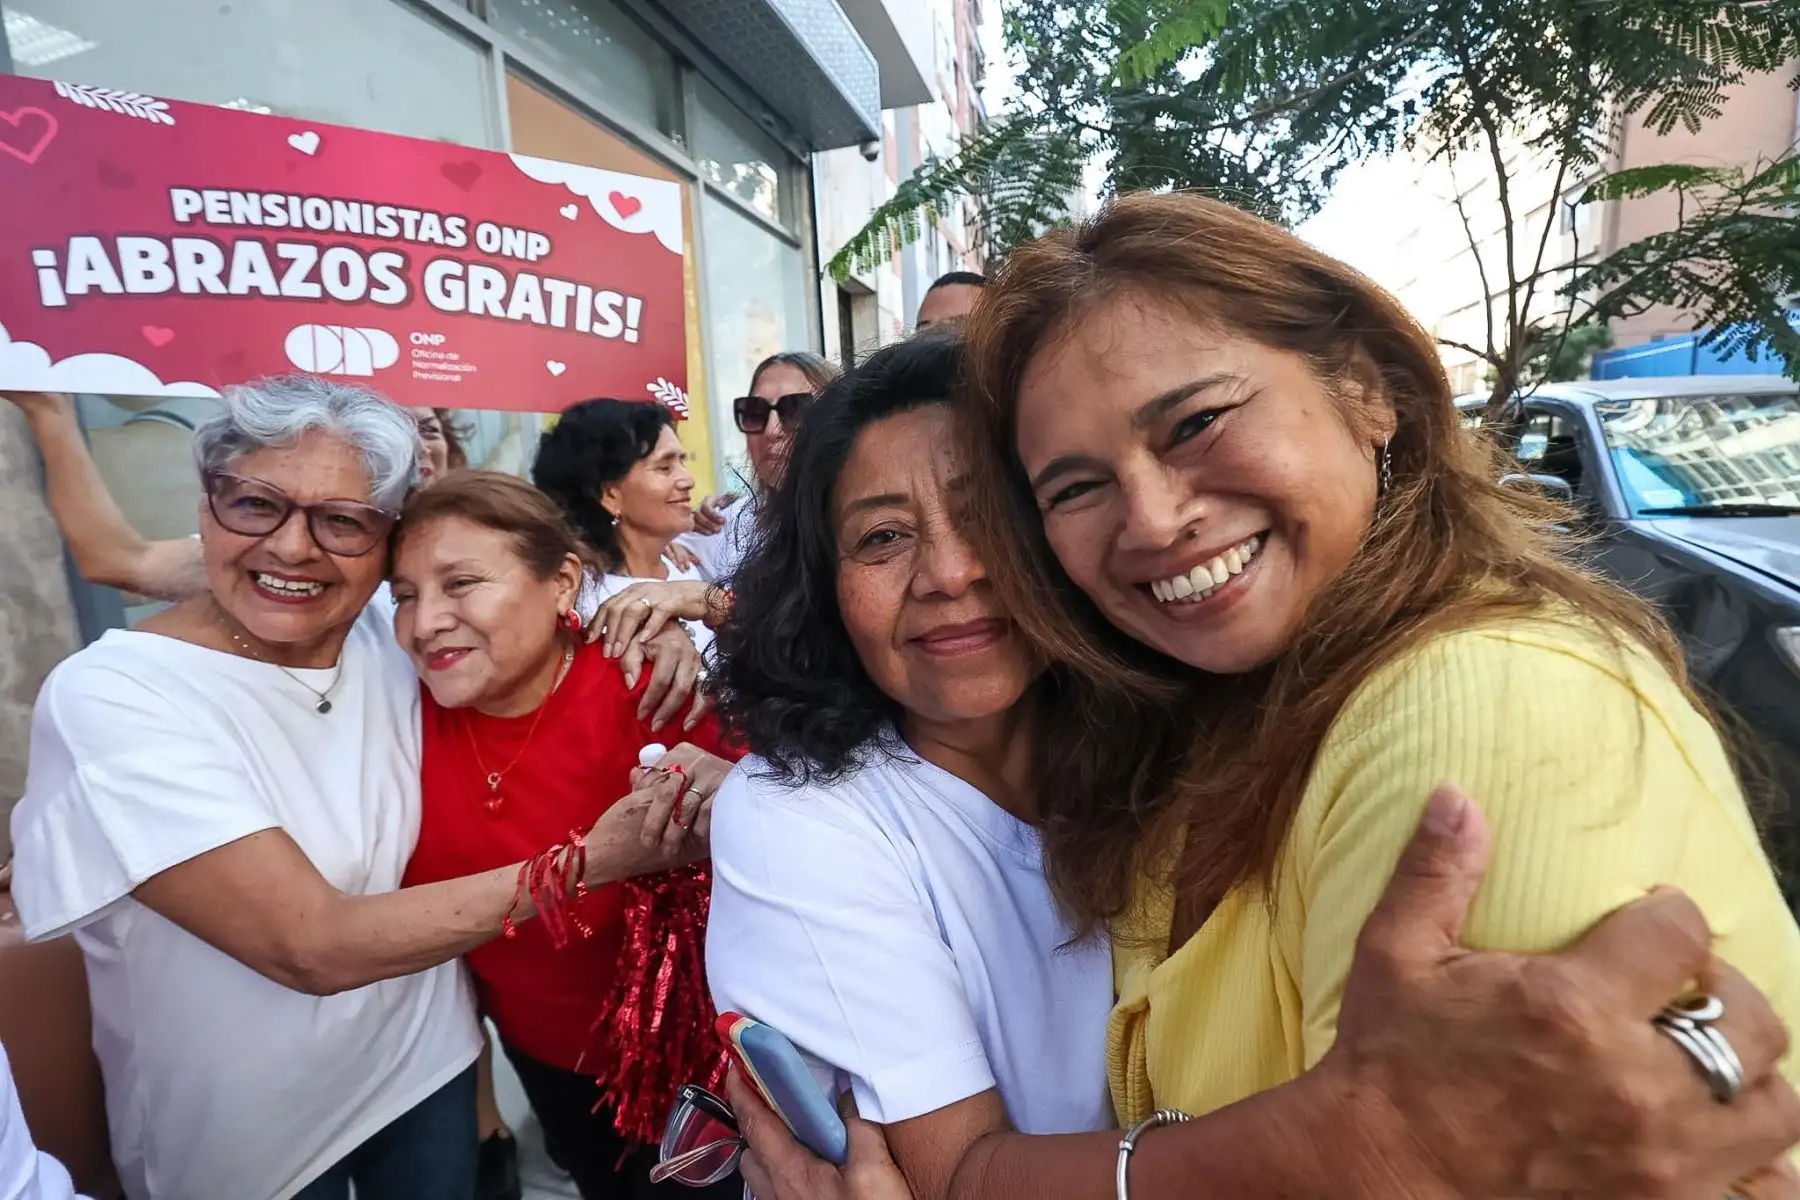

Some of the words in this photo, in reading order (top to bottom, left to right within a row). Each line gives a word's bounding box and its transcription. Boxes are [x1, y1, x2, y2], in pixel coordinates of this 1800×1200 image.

[170, 188, 468, 248] PENSIONISTAS
[475, 222, 551, 262] ONP
[31, 236, 407, 307] ¡ABRAZOS
[423, 259, 643, 343] GRATIS!
[410, 332, 446, 346] ONP
